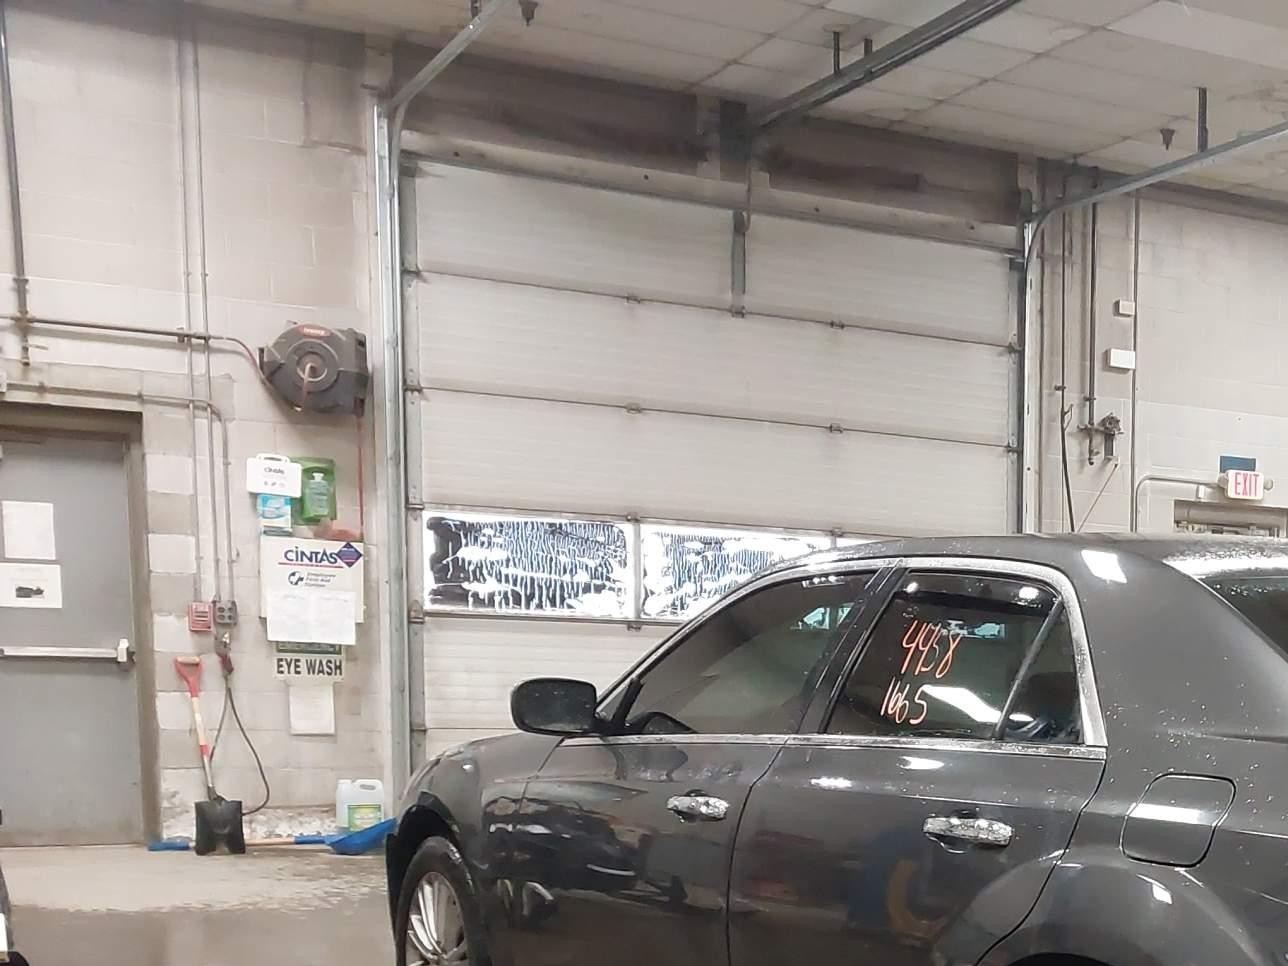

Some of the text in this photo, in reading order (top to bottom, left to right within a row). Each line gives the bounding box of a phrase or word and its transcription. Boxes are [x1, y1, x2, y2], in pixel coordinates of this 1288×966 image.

[1234, 472, 1260, 496] EXIT
[276, 657, 343, 677] EYE WASH
